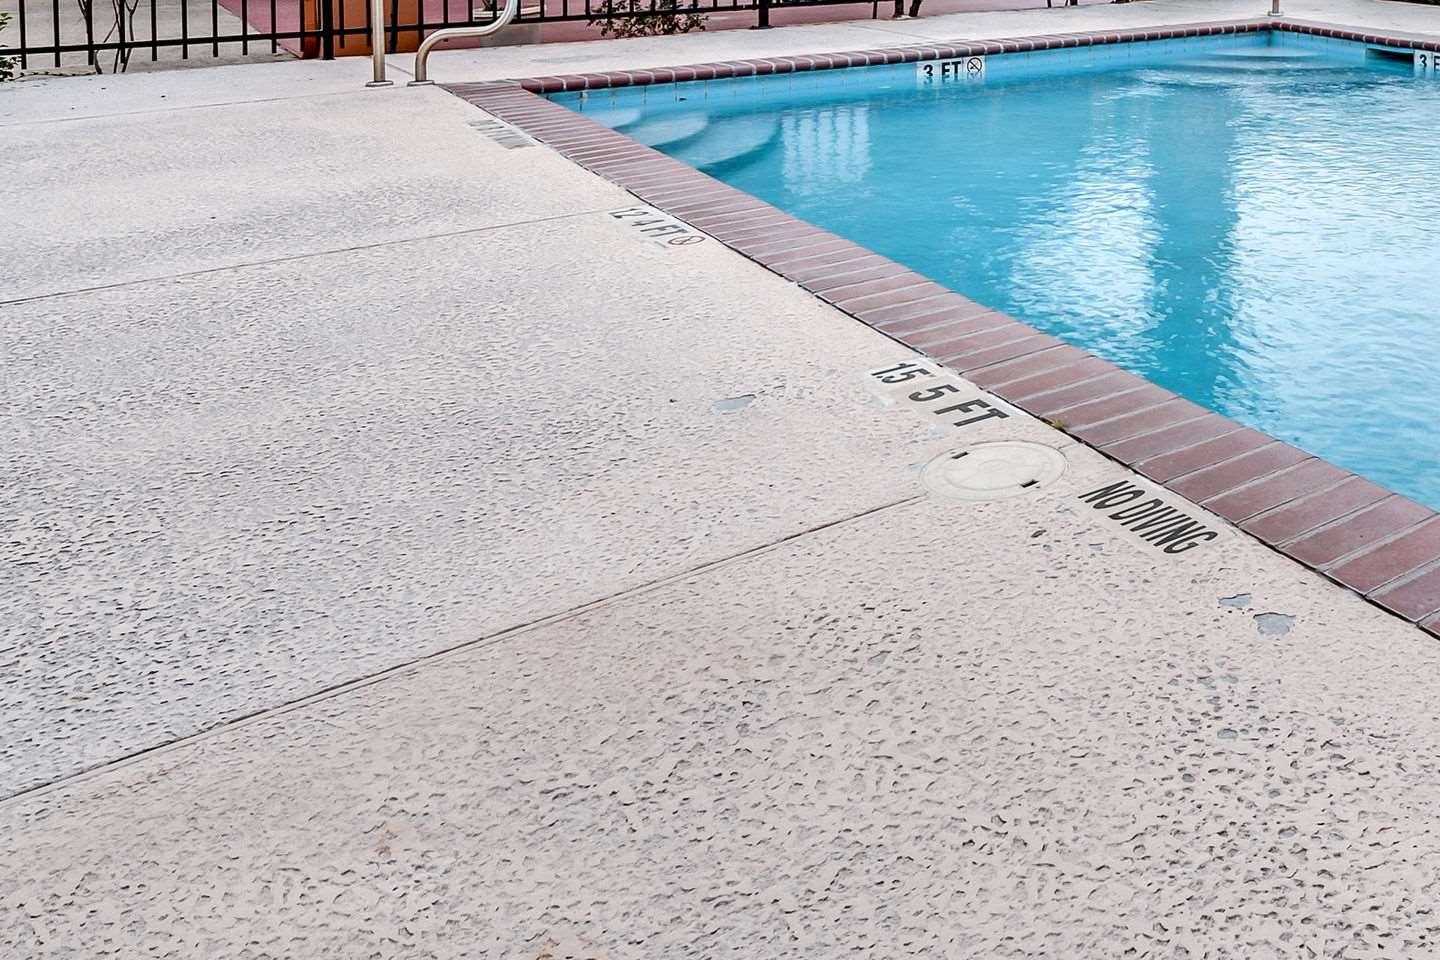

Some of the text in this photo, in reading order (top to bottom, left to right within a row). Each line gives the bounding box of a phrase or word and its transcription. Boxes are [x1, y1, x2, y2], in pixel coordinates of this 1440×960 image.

[640, 225, 688, 237] FT
[908, 384, 960, 402] 5
[933, 398, 1010, 428] FT
[1077, 480, 1218, 554] NO DIVING
